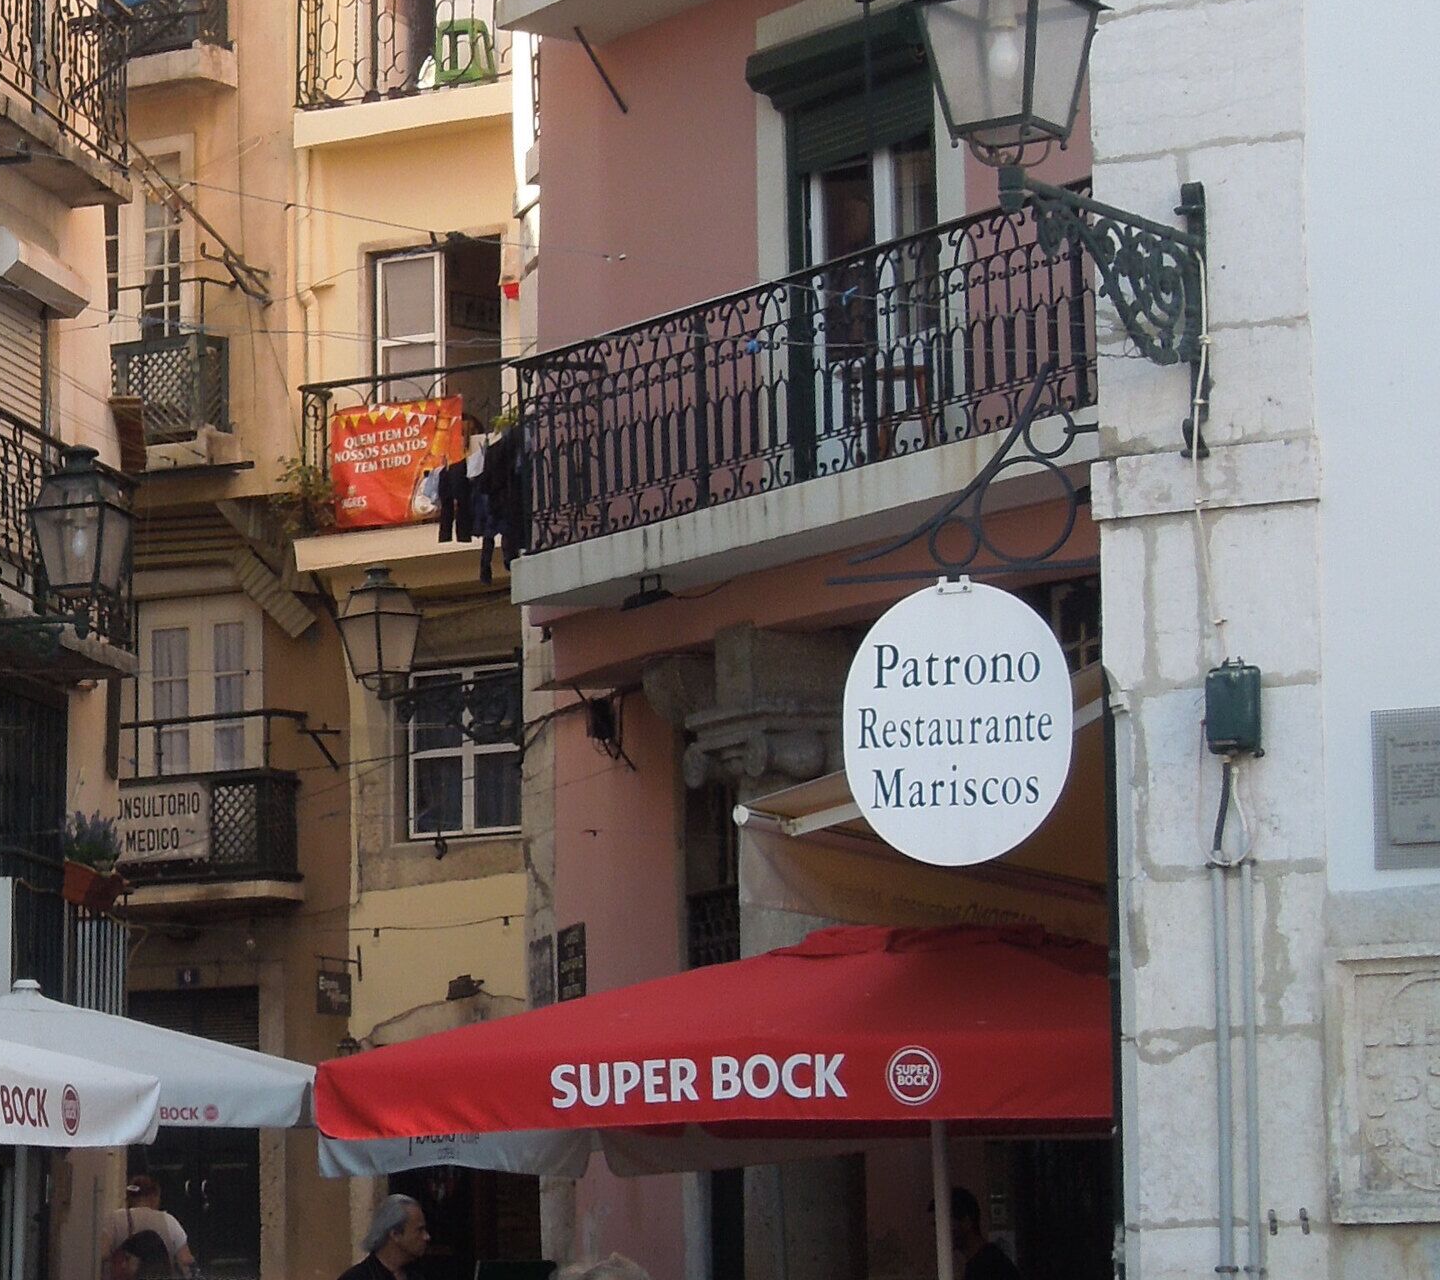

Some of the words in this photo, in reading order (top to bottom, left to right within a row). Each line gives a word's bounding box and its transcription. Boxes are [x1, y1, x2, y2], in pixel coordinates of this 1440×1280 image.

[344, 434, 375, 449] QUEM
[380, 429, 400, 442] TEM
[404, 424, 419, 437] OS
[334, 446, 378, 463] NOSSOS
[381, 437, 427, 456] SANTOS
[354, 461, 377, 473] TEM
[381, 455, 411, 469] TUDO
[873, 644, 1040, 689] Patrono
[858, 707, 1052, 749] Restaurante
[871, 764, 1040, 809] Mariscos
[126, 827, 179, 852] MEDICO
[550, 1058, 699, 1109] SUPER
[711, 1053, 848, 1101] BOCK
[895, 1063, 930, 1076] SUPER
[897, 1074, 929, 1087] BOCK
[0, 1085, 49, 1128] BOCK
